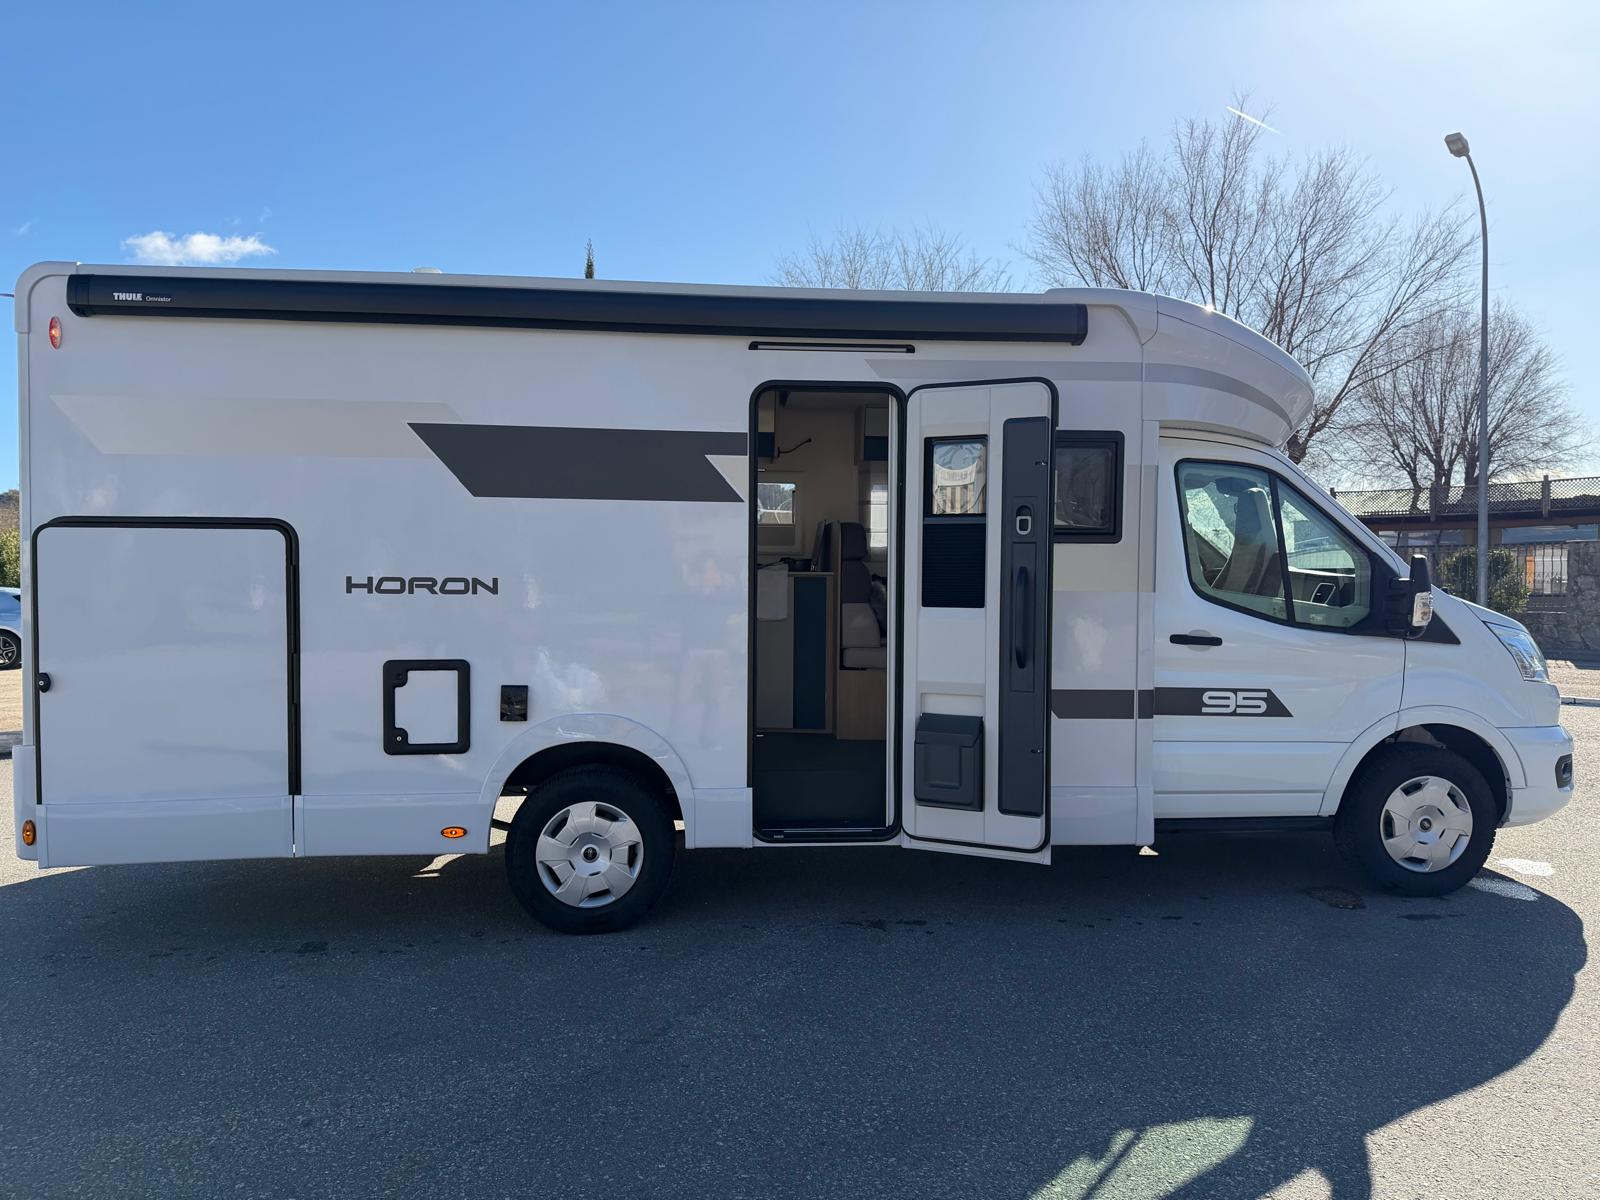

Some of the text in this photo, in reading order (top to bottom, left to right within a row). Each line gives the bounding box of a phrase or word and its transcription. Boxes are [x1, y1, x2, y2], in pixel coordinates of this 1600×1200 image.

[113, 292, 172, 303] THULE Omnistor
[345, 575, 499, 595] HORON
[1201, 690, 1268, 714] 95
